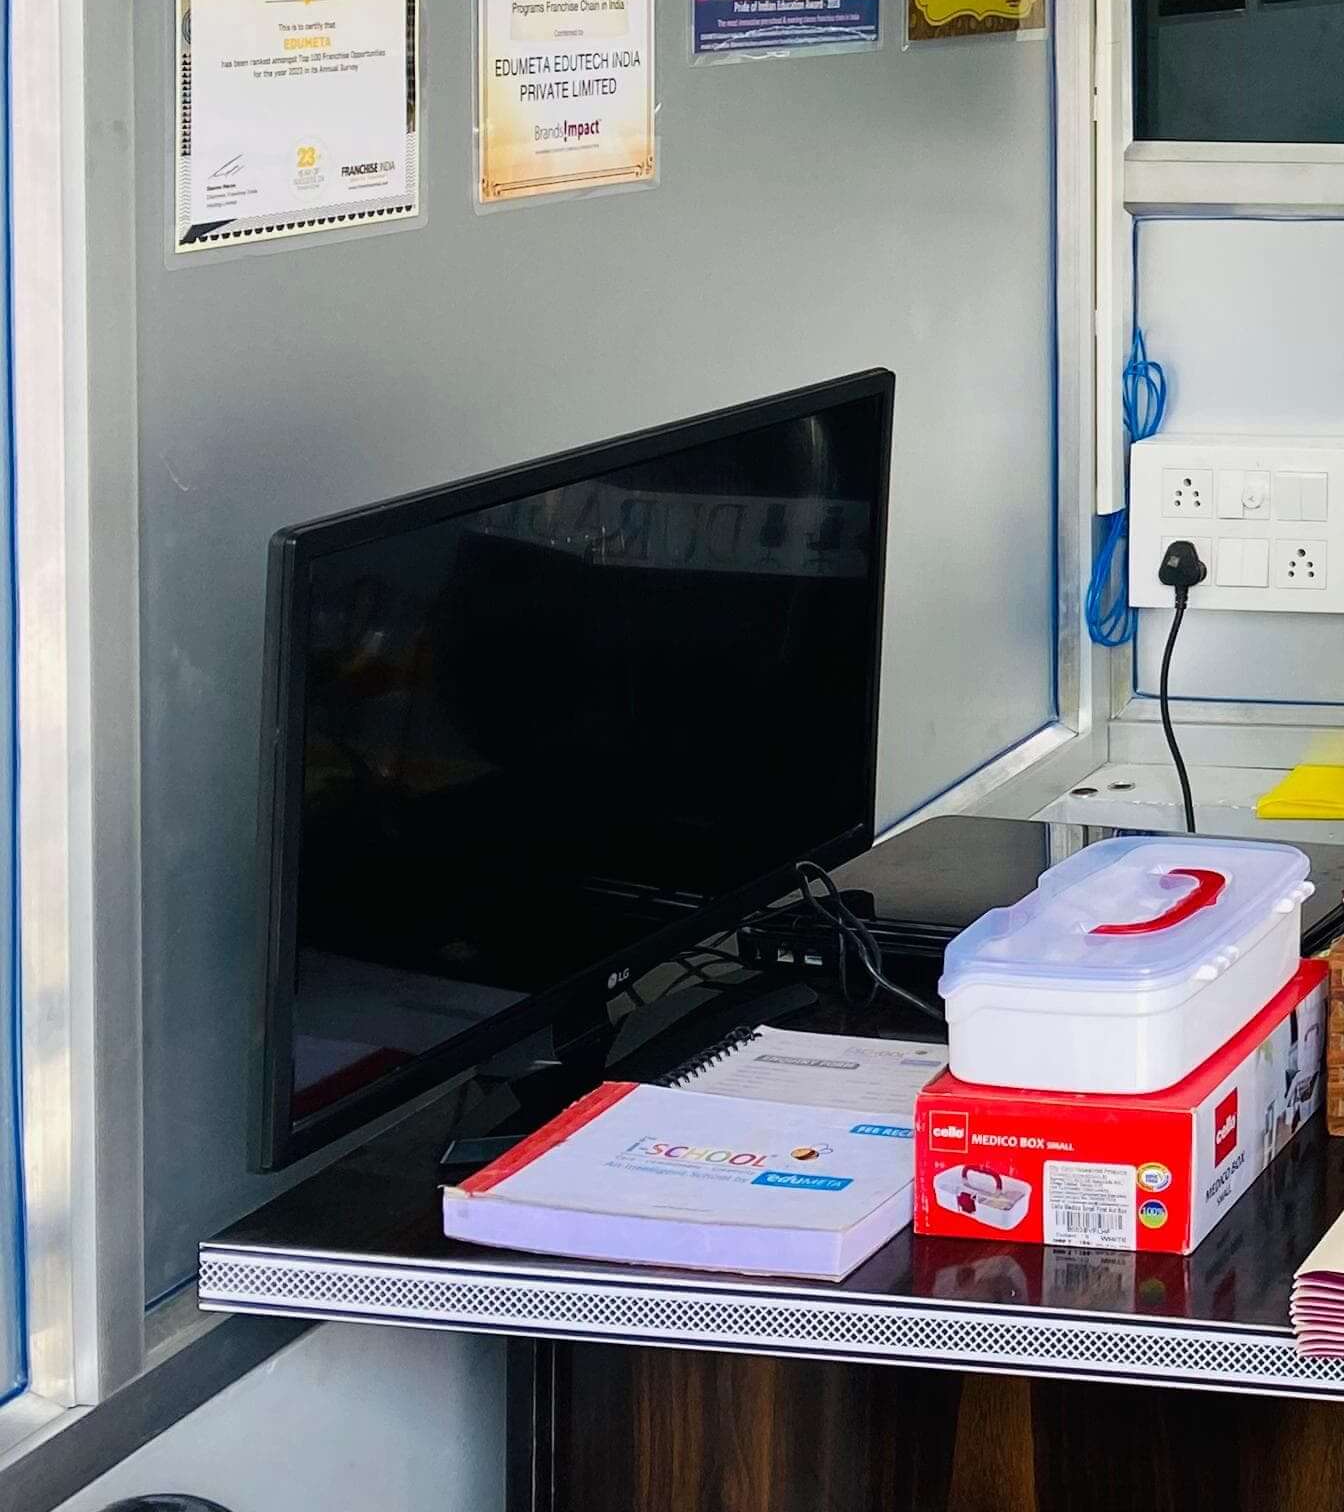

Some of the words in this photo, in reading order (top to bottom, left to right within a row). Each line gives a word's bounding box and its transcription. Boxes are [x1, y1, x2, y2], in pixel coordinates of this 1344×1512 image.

[512, 2, 545, 16] Programs
[546, 0, 579, 13] Franchise
[580, 0, 600, 12] Chain
[608, 0, 625, 10] India
[283, 36, 331, 50] EDUMETA
[495, 55, 550, 77] EDUMETA
[554, 52, 609, 73] EDUTECH
[612, 50, 641, 69] INDIA
[520, 81, 569, 101] PRIVATE
[572, 77, 617, 98] LIMITED
[341, 162, 379, 177] FRANCHISE
[617, 968, 630, 981] LG
[932, 1125, 965, 1139] cello
[1216, 1113, 1236, 1145] cello
[971, 1133, 1018, 1148] MEDICO
[1020, 1136, 1045, 1150] BOX
[1046, 1141, 1075, 1151] SMALL
[625, 1136, 767, 1168] i-SCHOOL
[766, 1172, 843, 1189] eduMETA
[1205, 1169, 1229, 1200] MEDICO
[1229, 1152, 1246, 1173] BOX
